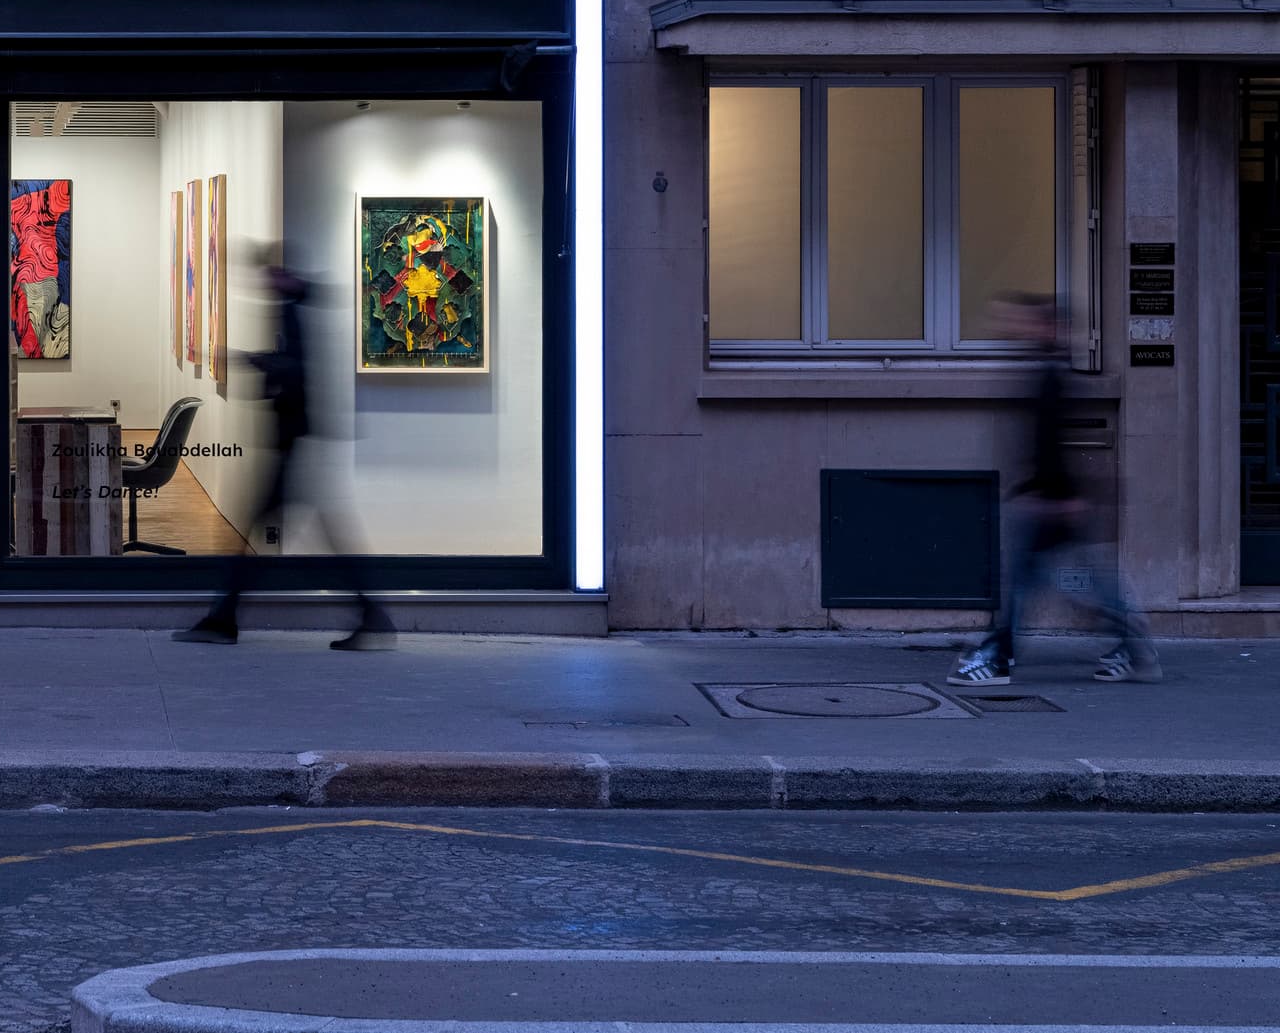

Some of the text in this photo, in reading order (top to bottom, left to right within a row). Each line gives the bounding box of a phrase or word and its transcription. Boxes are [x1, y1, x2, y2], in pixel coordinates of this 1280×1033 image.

[52, 443, 243, 457] Zoulikha Bouabdellah
[52, 485, 159, 499] Let's Dance!
